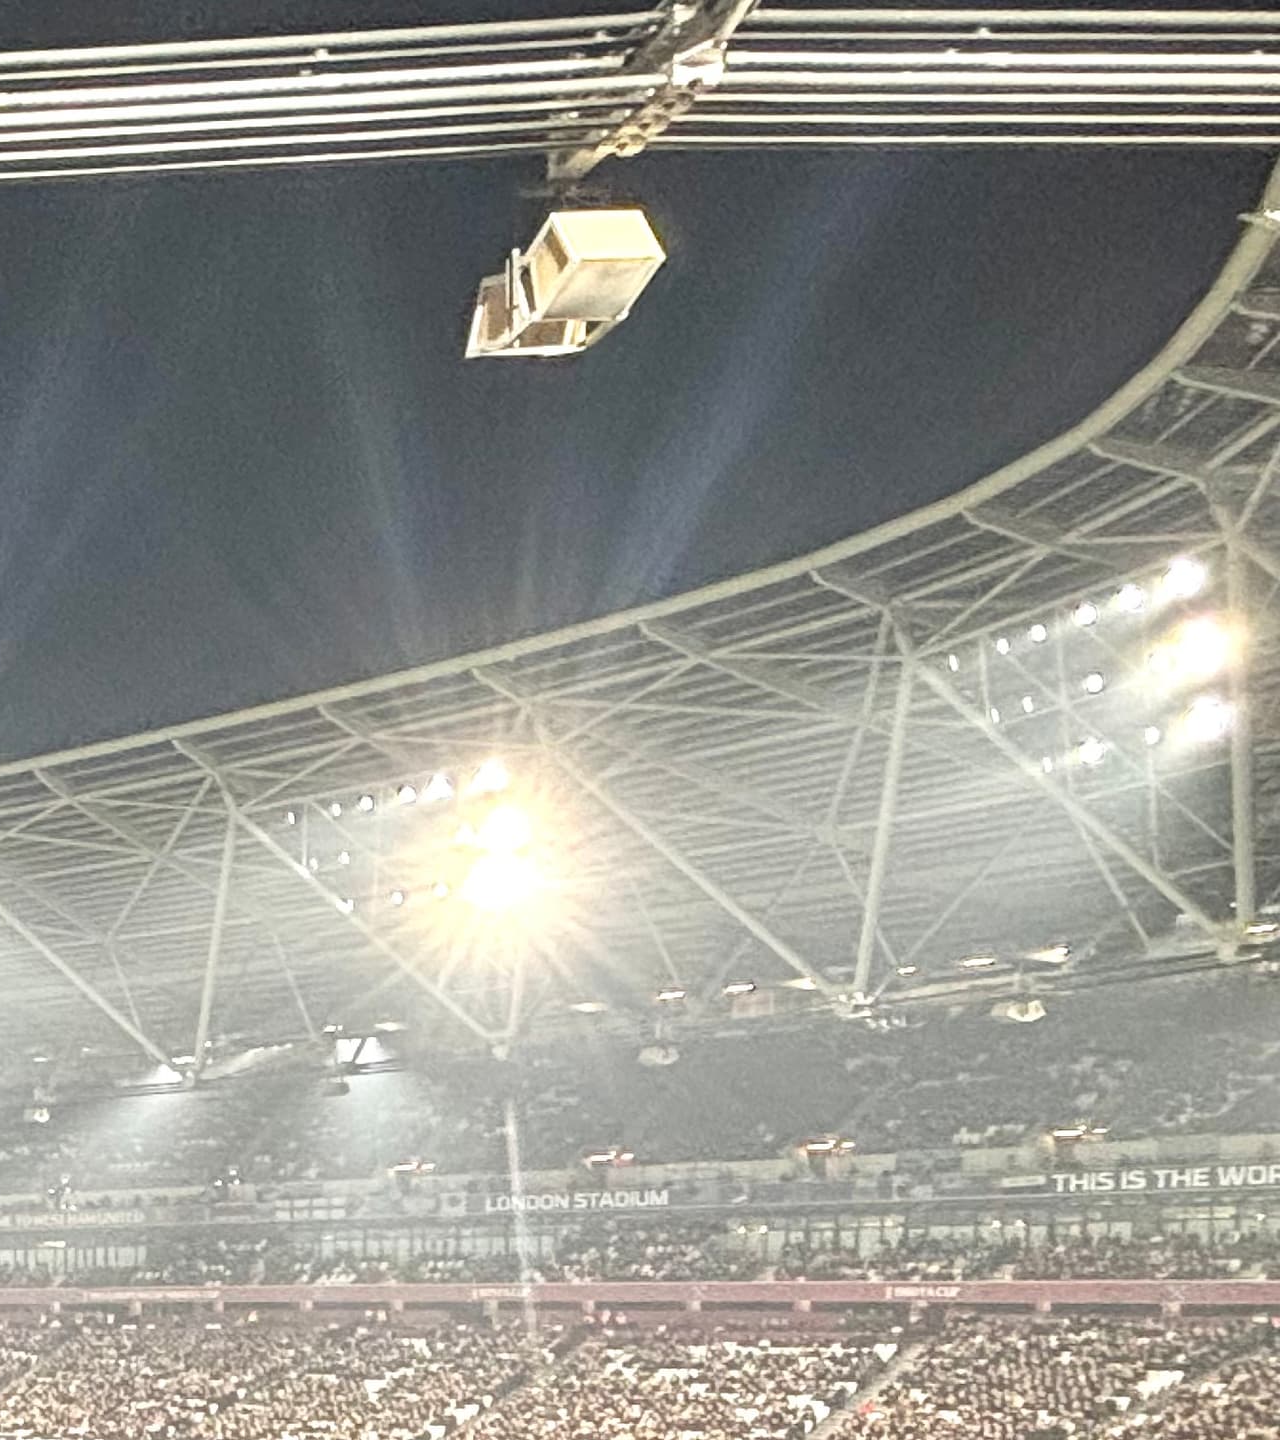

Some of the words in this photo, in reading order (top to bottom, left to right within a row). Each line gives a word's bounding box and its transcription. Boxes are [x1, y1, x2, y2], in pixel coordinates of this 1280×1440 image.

[1051, 1172, 1115, 1193] THIS
[1120, 1170, 1147, 1191] IS
[1153, 1167, 1210, 1189] THE
[486, 1193, 570, 1213] LONDON
[573, 1189, 670, 1209] STADIUM
